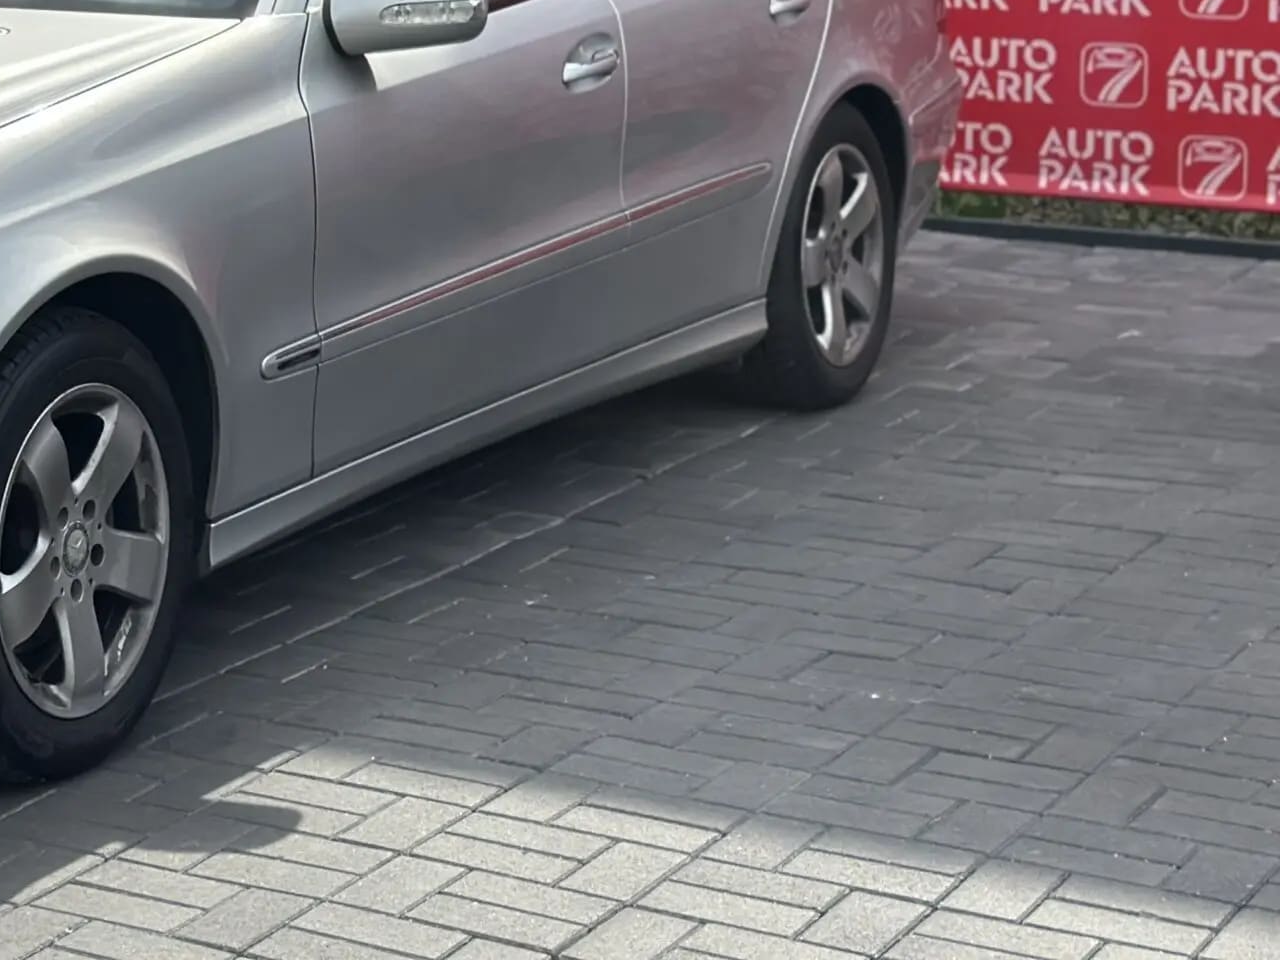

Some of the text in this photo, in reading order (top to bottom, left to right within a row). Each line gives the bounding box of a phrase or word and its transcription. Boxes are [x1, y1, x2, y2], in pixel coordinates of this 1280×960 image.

[949, 38, 1056, 70] AUTO
[1168, 48, 1280, 83] AUTO
[1168, 79, 1280, 117] PARK
[1040, 128, 1153, 162] AUTO
[1039, 159, 1150, 197] PARK
